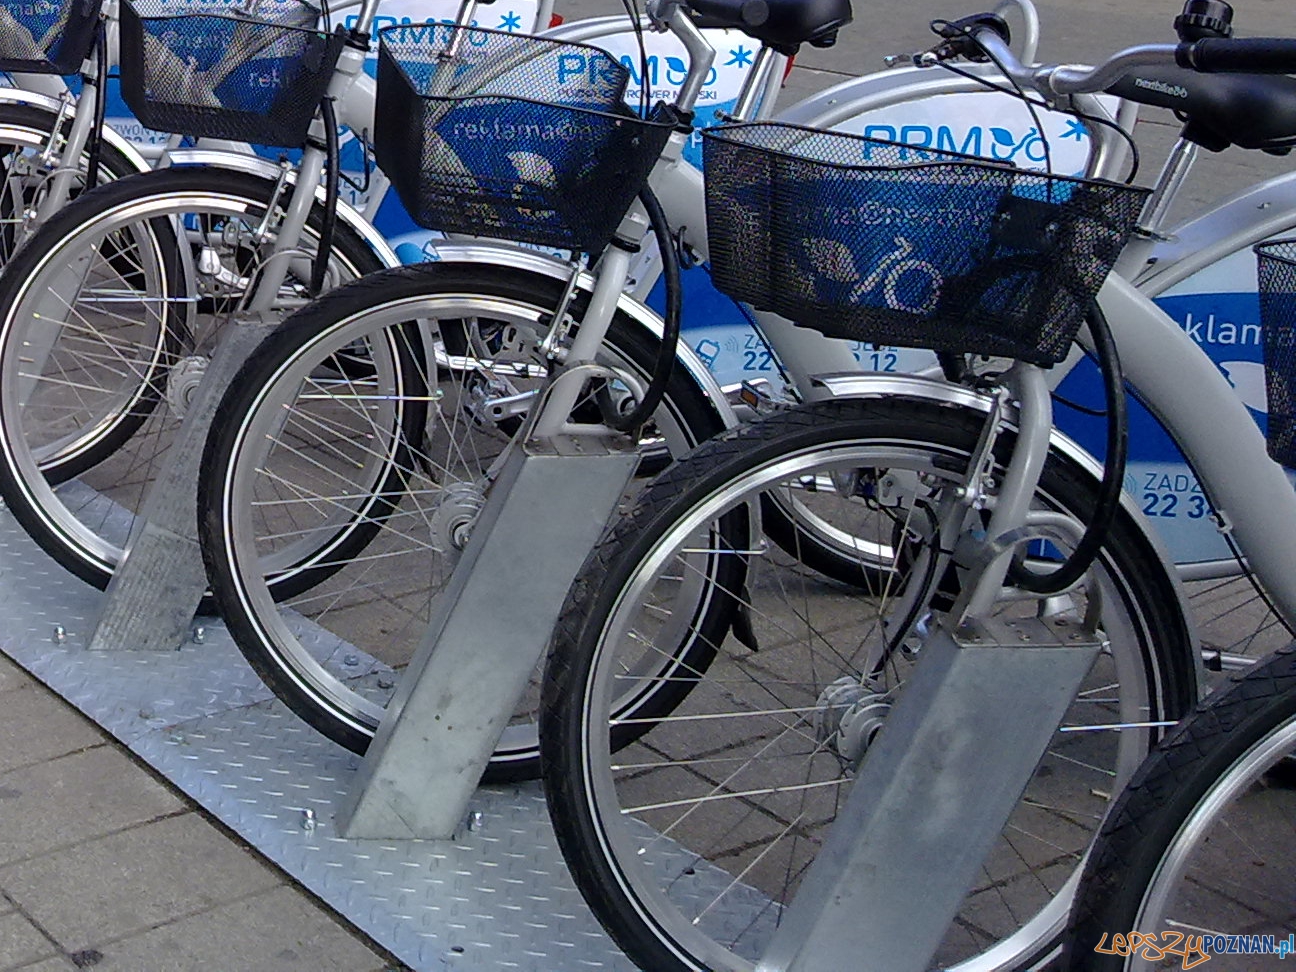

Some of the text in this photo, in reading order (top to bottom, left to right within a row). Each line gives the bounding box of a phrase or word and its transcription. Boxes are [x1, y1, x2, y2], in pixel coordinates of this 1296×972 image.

[863, 125, 983, 162] PRM
[743, 351, 898, 372] 22 12
[1143, 494, 1177, 517] 22
